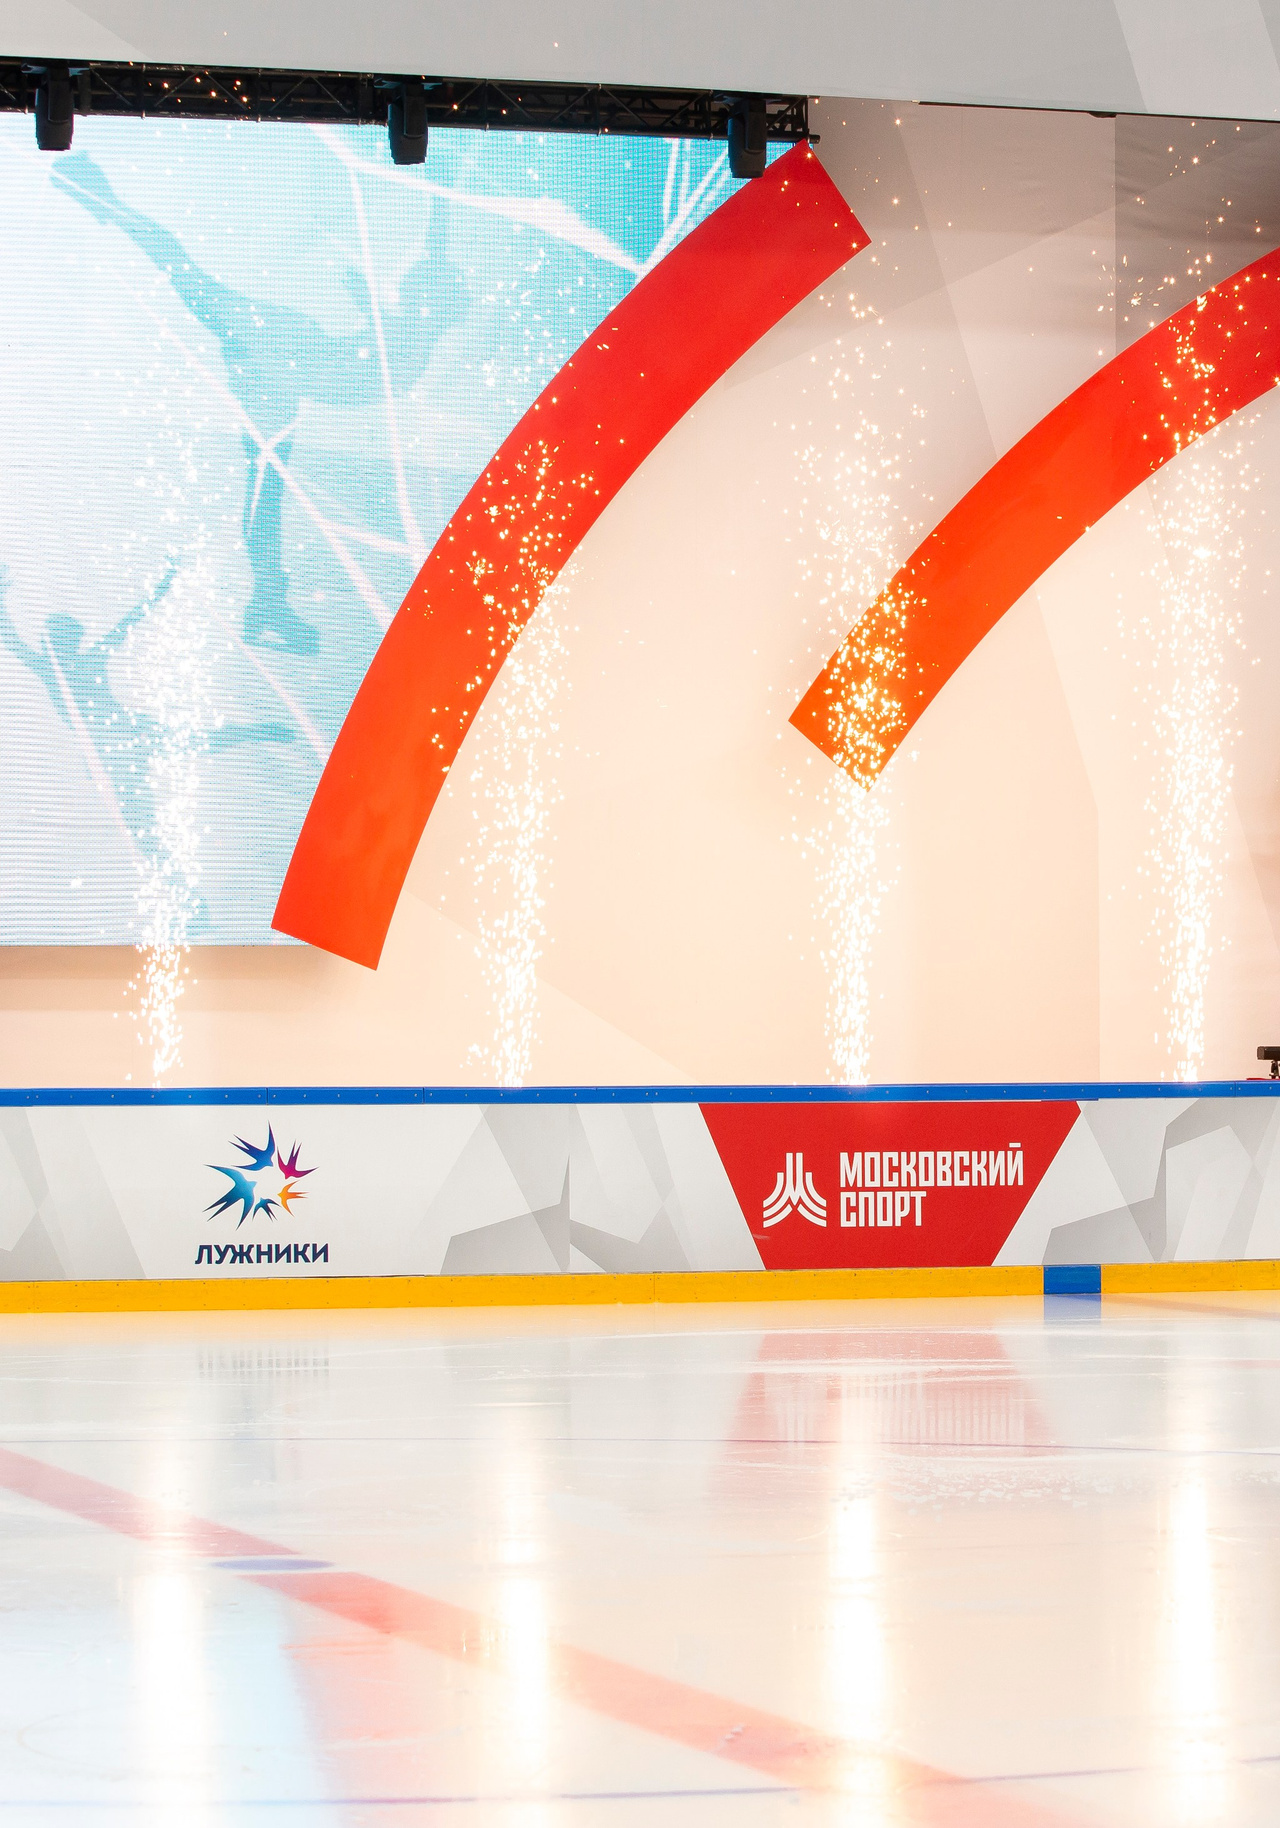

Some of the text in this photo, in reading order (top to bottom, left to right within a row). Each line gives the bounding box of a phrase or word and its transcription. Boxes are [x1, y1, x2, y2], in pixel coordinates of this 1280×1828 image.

[839, 1142, 1024, 1188] МОСКОВСКИЙ
[840, 1191, 927, 1227] СПОРТ
[194, 1243, 329, 1264] ЛУЖНИКИ
